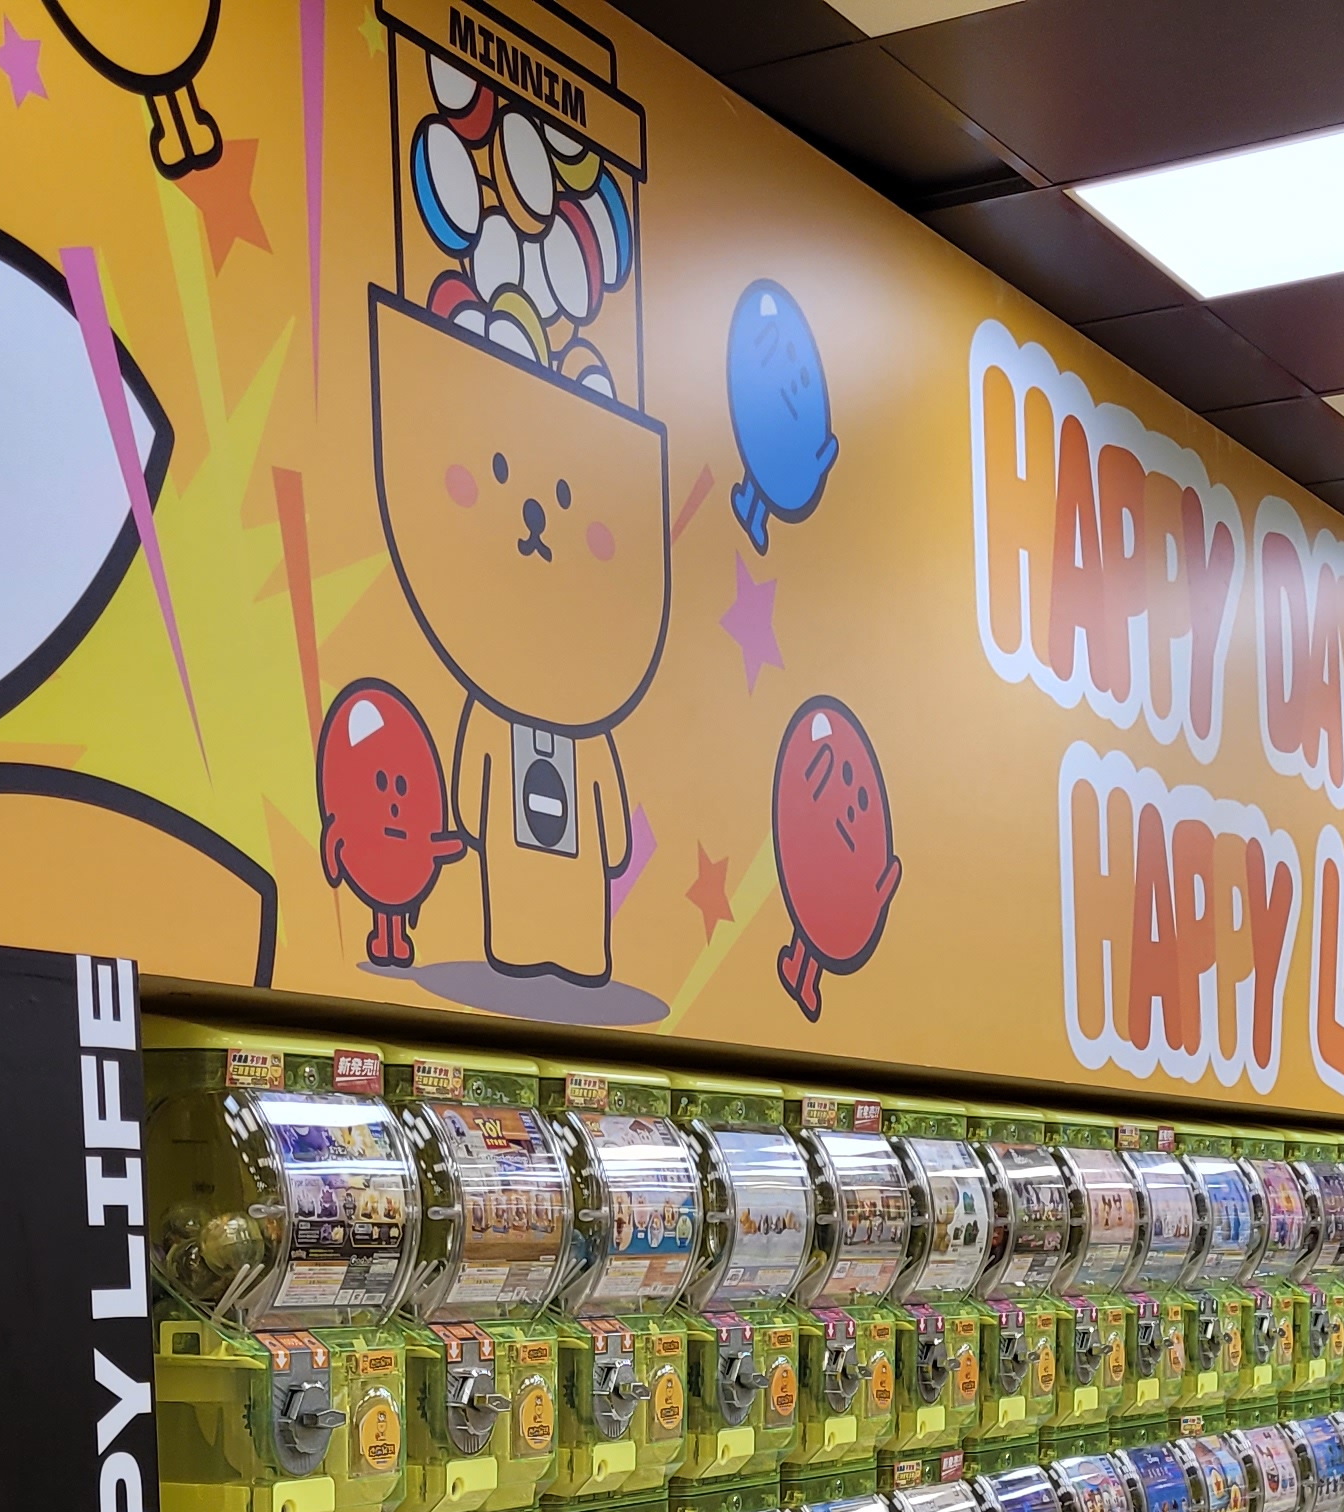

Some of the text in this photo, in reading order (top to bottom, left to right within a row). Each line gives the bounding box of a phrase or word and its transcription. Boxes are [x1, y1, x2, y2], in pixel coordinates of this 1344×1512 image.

[449, 6, 588, 129] MINNIM
[978, 350, 1239, 750] HAPPY
[337, 1055, 381, 1077] 新発売!!
[1066, 762, 1297, 1082] HAPPY
[75, 954, 148, 1320] LIFE
